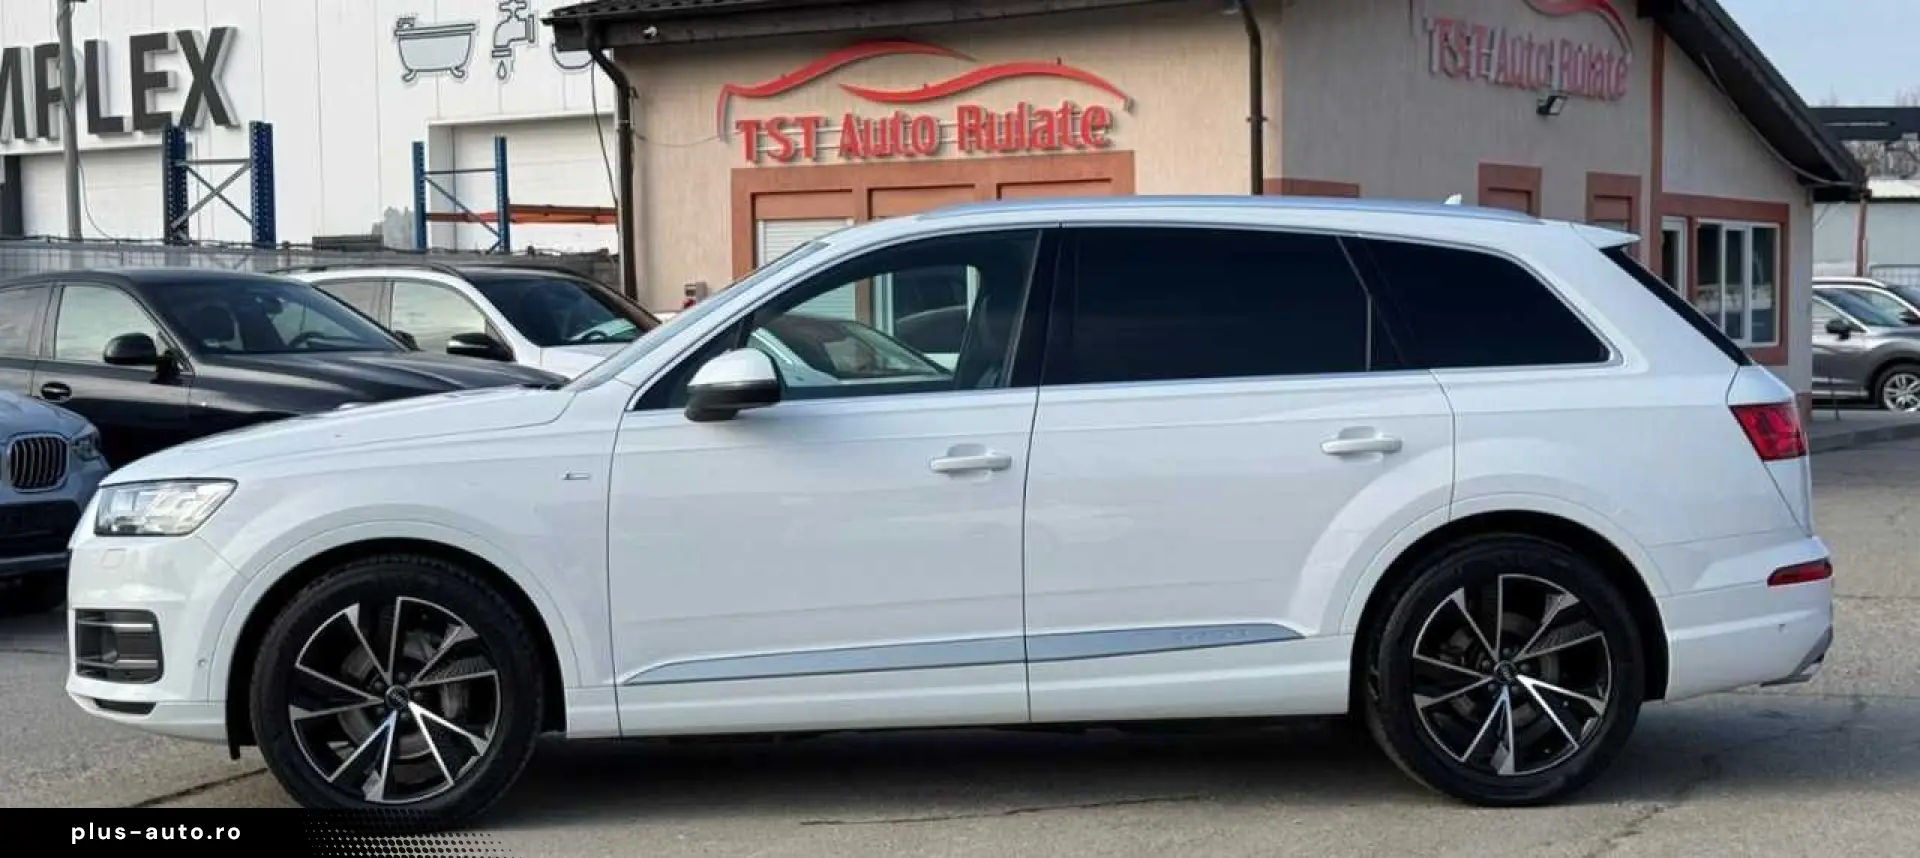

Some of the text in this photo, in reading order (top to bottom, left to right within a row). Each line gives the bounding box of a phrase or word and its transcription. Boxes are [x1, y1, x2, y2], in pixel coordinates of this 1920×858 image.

[1493, 33, 1550, 90] Auto
[735, 101, 1114, 162] TST Auto Rulate
